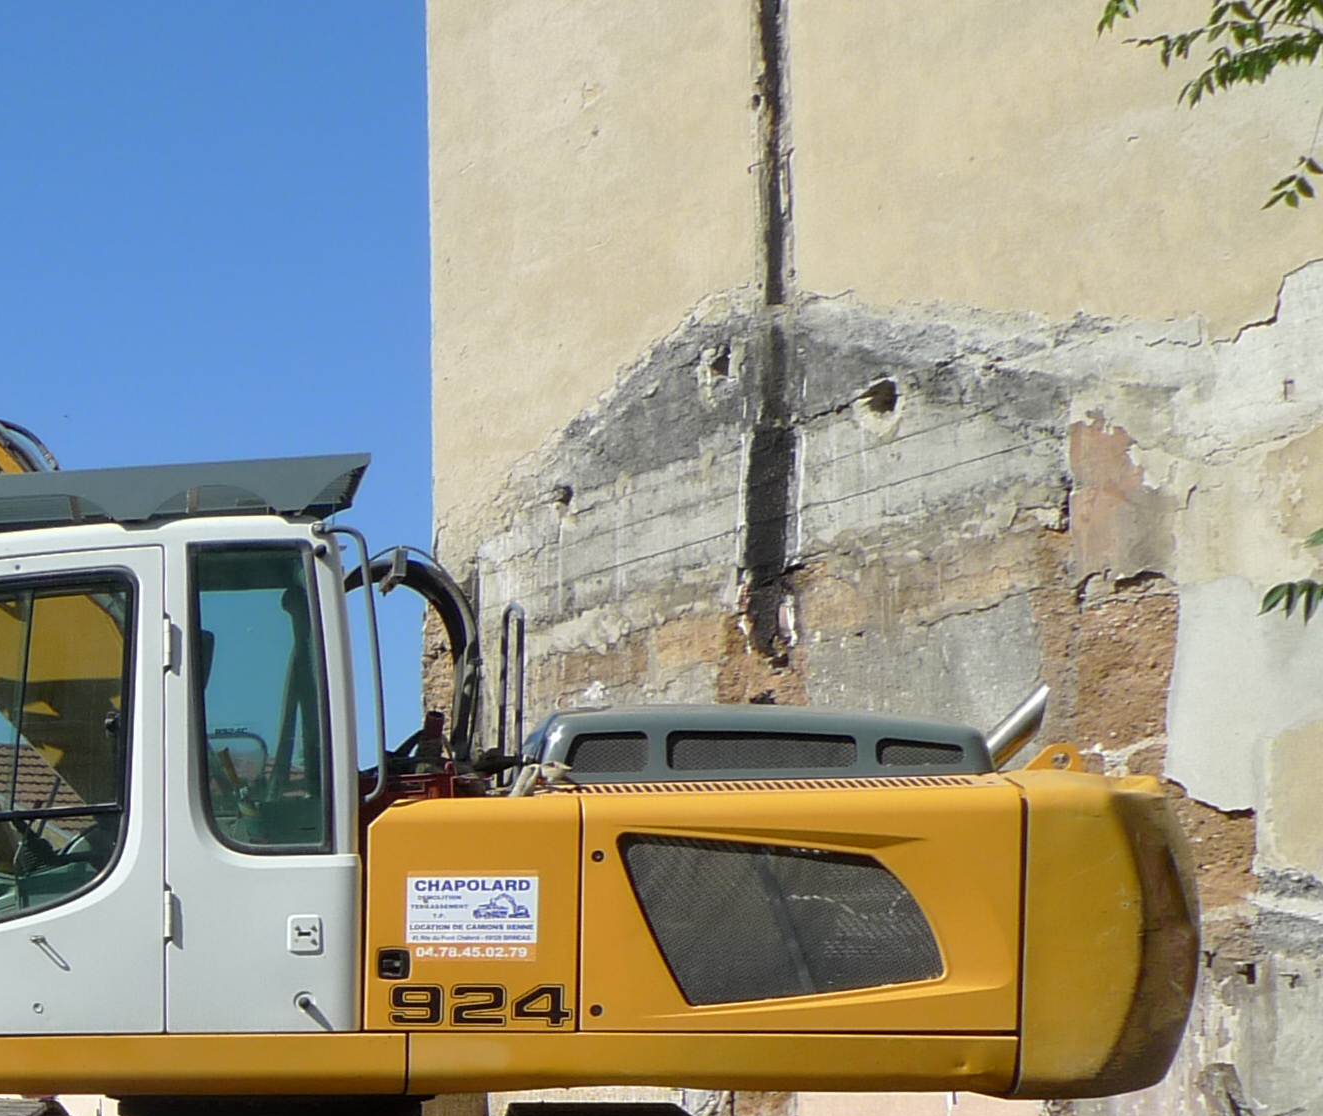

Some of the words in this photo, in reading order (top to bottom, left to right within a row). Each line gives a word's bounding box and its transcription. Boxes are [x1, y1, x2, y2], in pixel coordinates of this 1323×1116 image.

[414, 880, 531, 892] CHAPOLARD
[415, 946, 528, 958] 04.78.45.02.79
[389, 983, 573, 1027] 924
